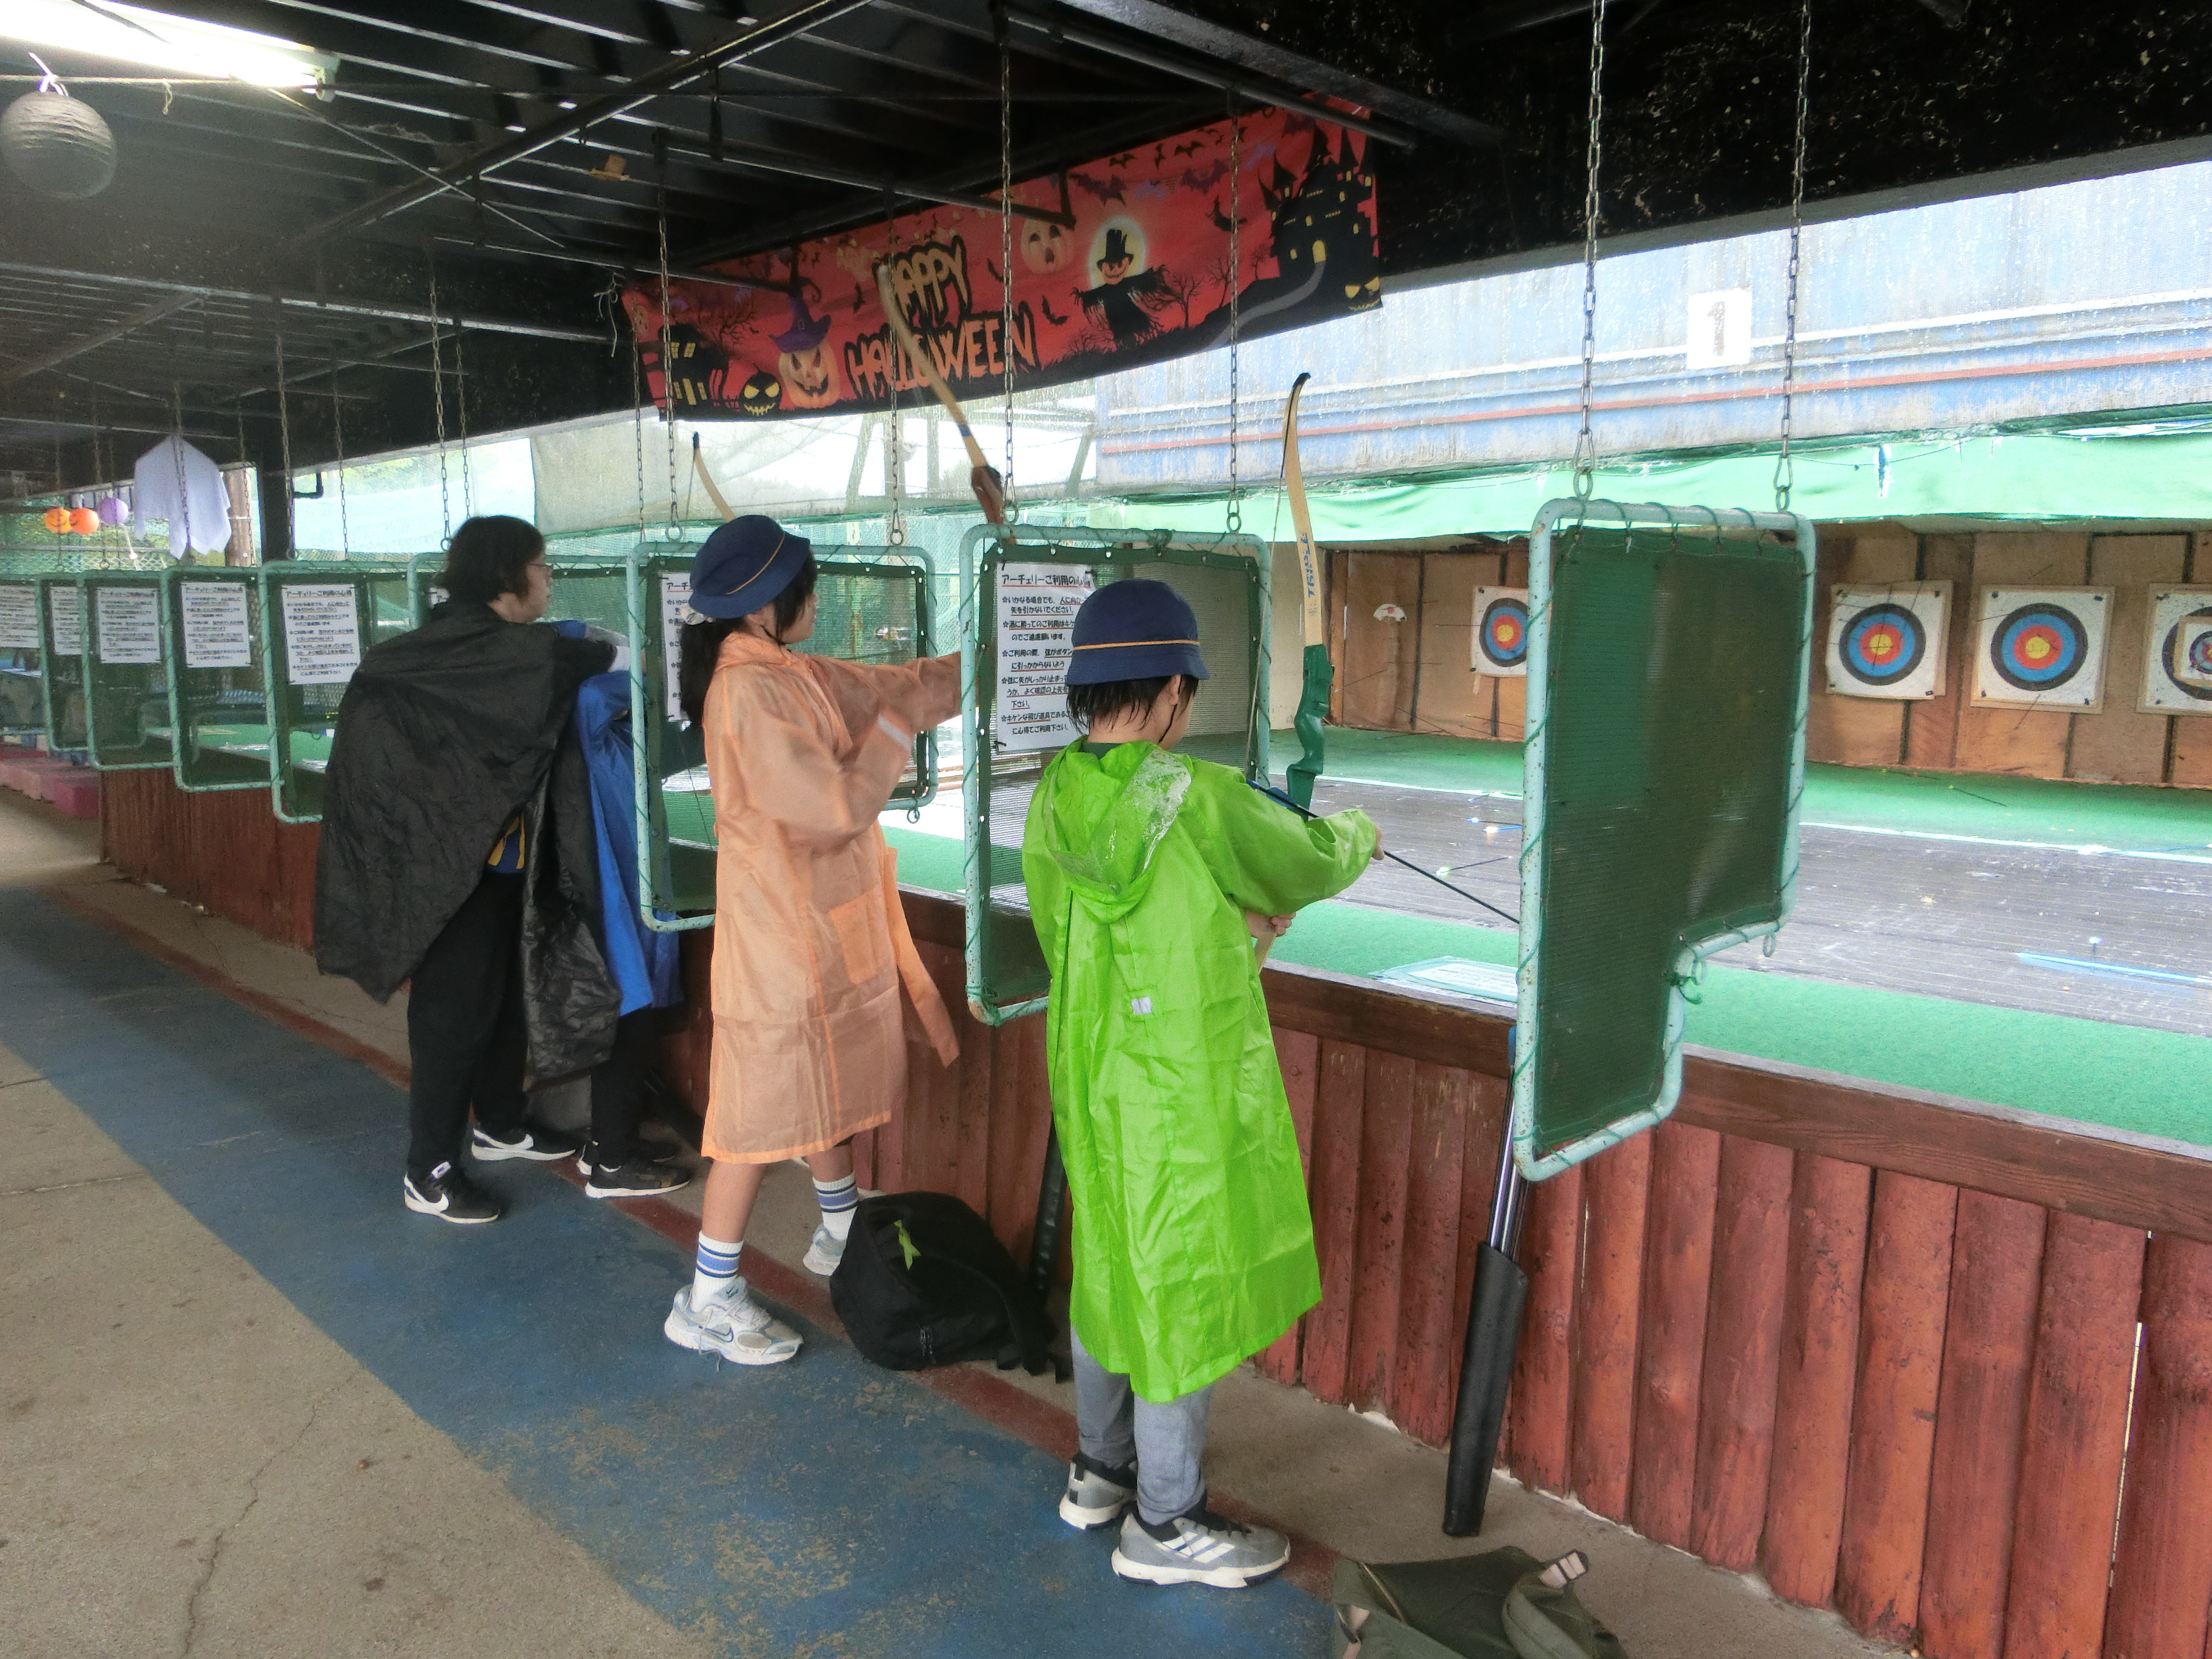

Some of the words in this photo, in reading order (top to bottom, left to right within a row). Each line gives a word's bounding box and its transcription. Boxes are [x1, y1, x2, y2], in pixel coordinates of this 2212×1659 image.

[874, 239, 970, 325] APPY
[846, 311, 1037, 402] HALLOWEEN
[1706, 301, 1726, 357] 1
